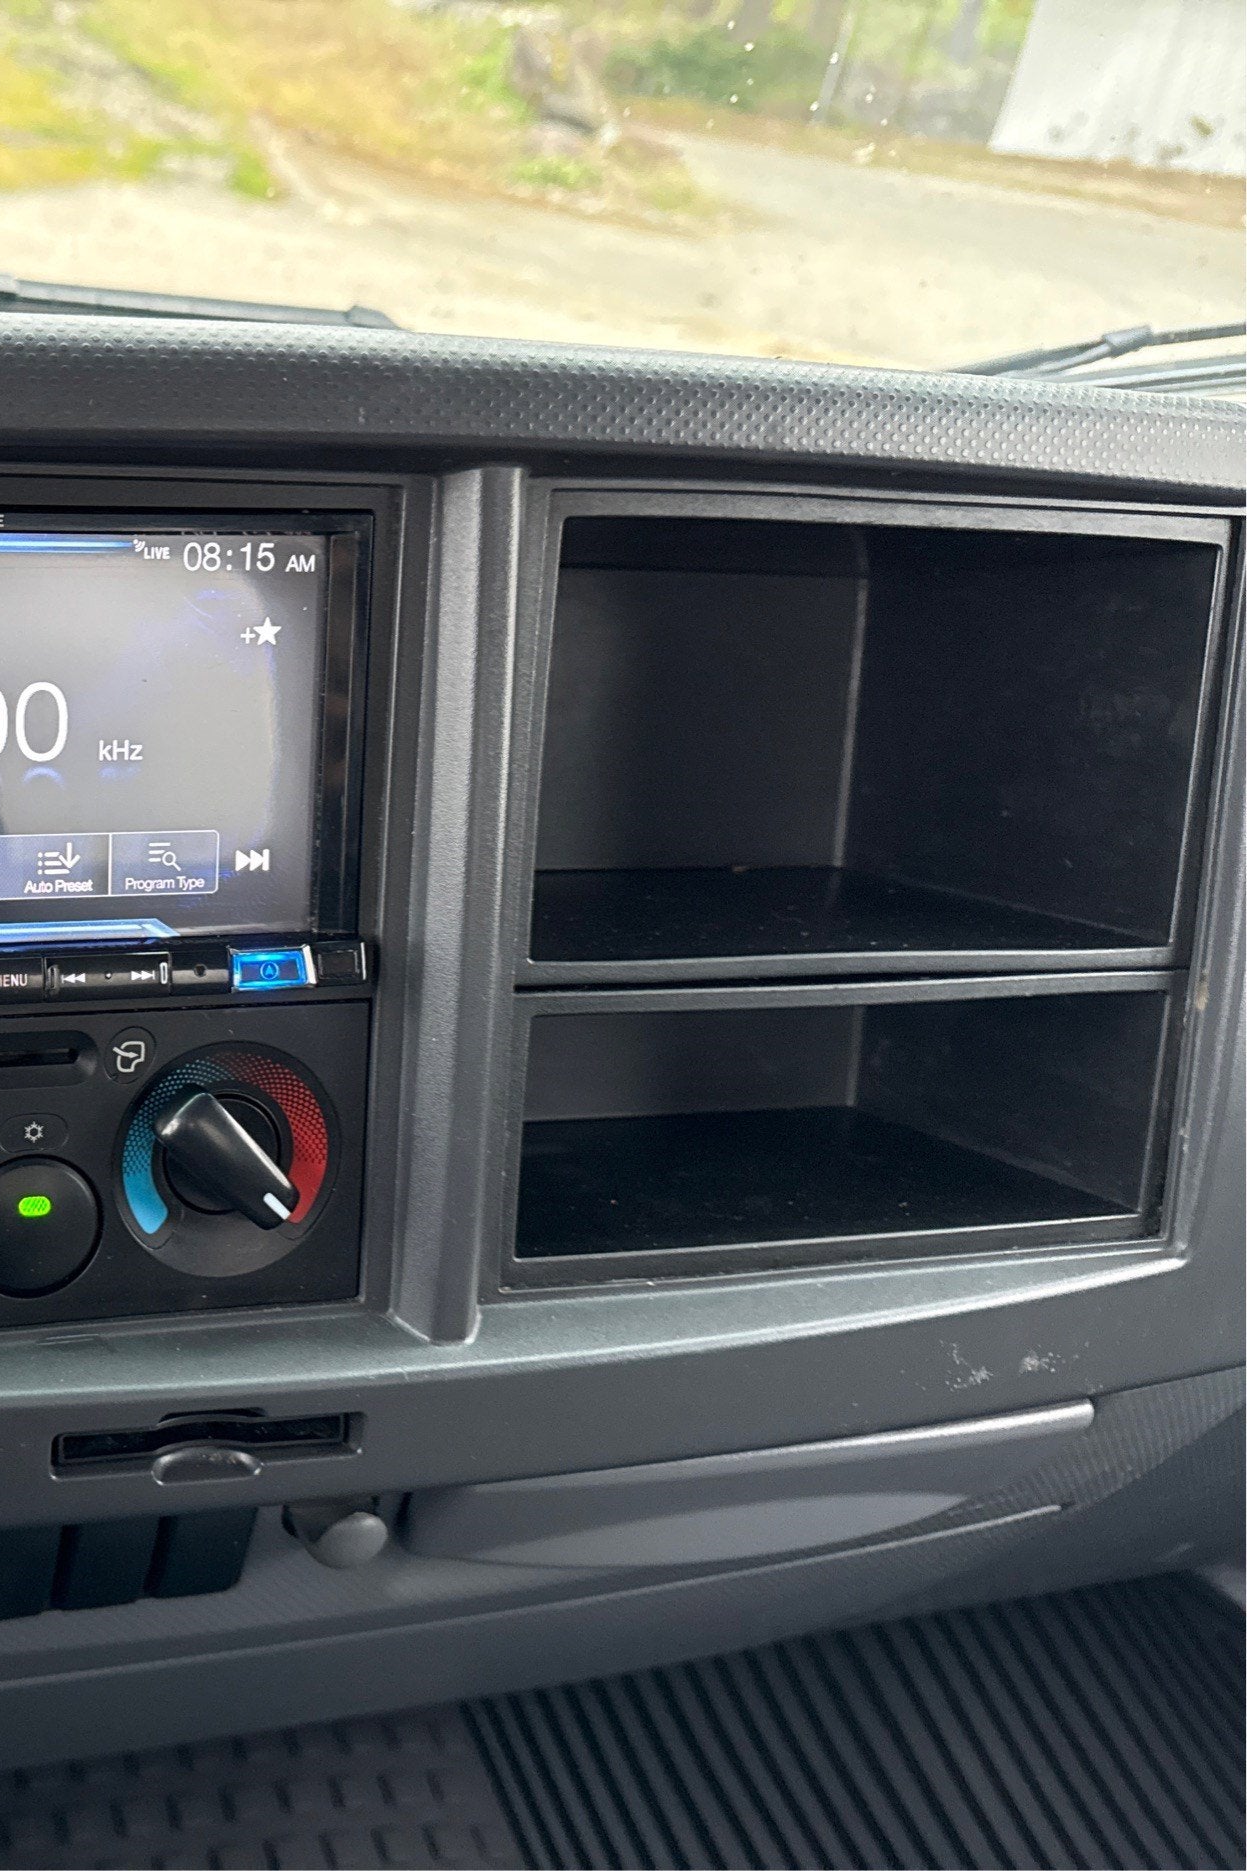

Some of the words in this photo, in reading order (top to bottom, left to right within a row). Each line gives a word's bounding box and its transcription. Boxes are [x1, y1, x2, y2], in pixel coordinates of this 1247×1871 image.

[143, 546, 170, 560] LIVE
[182, 541, 276, 573] 08:15
[285, 554, 317, 573] AM
[98, 739, 143, 762] kHz
[24, 879, 52, 894] Auto
[55, 879, 93, 893] Preset
[125, 877, 174, 892] Program
[176, 876, 206, 890] Type
